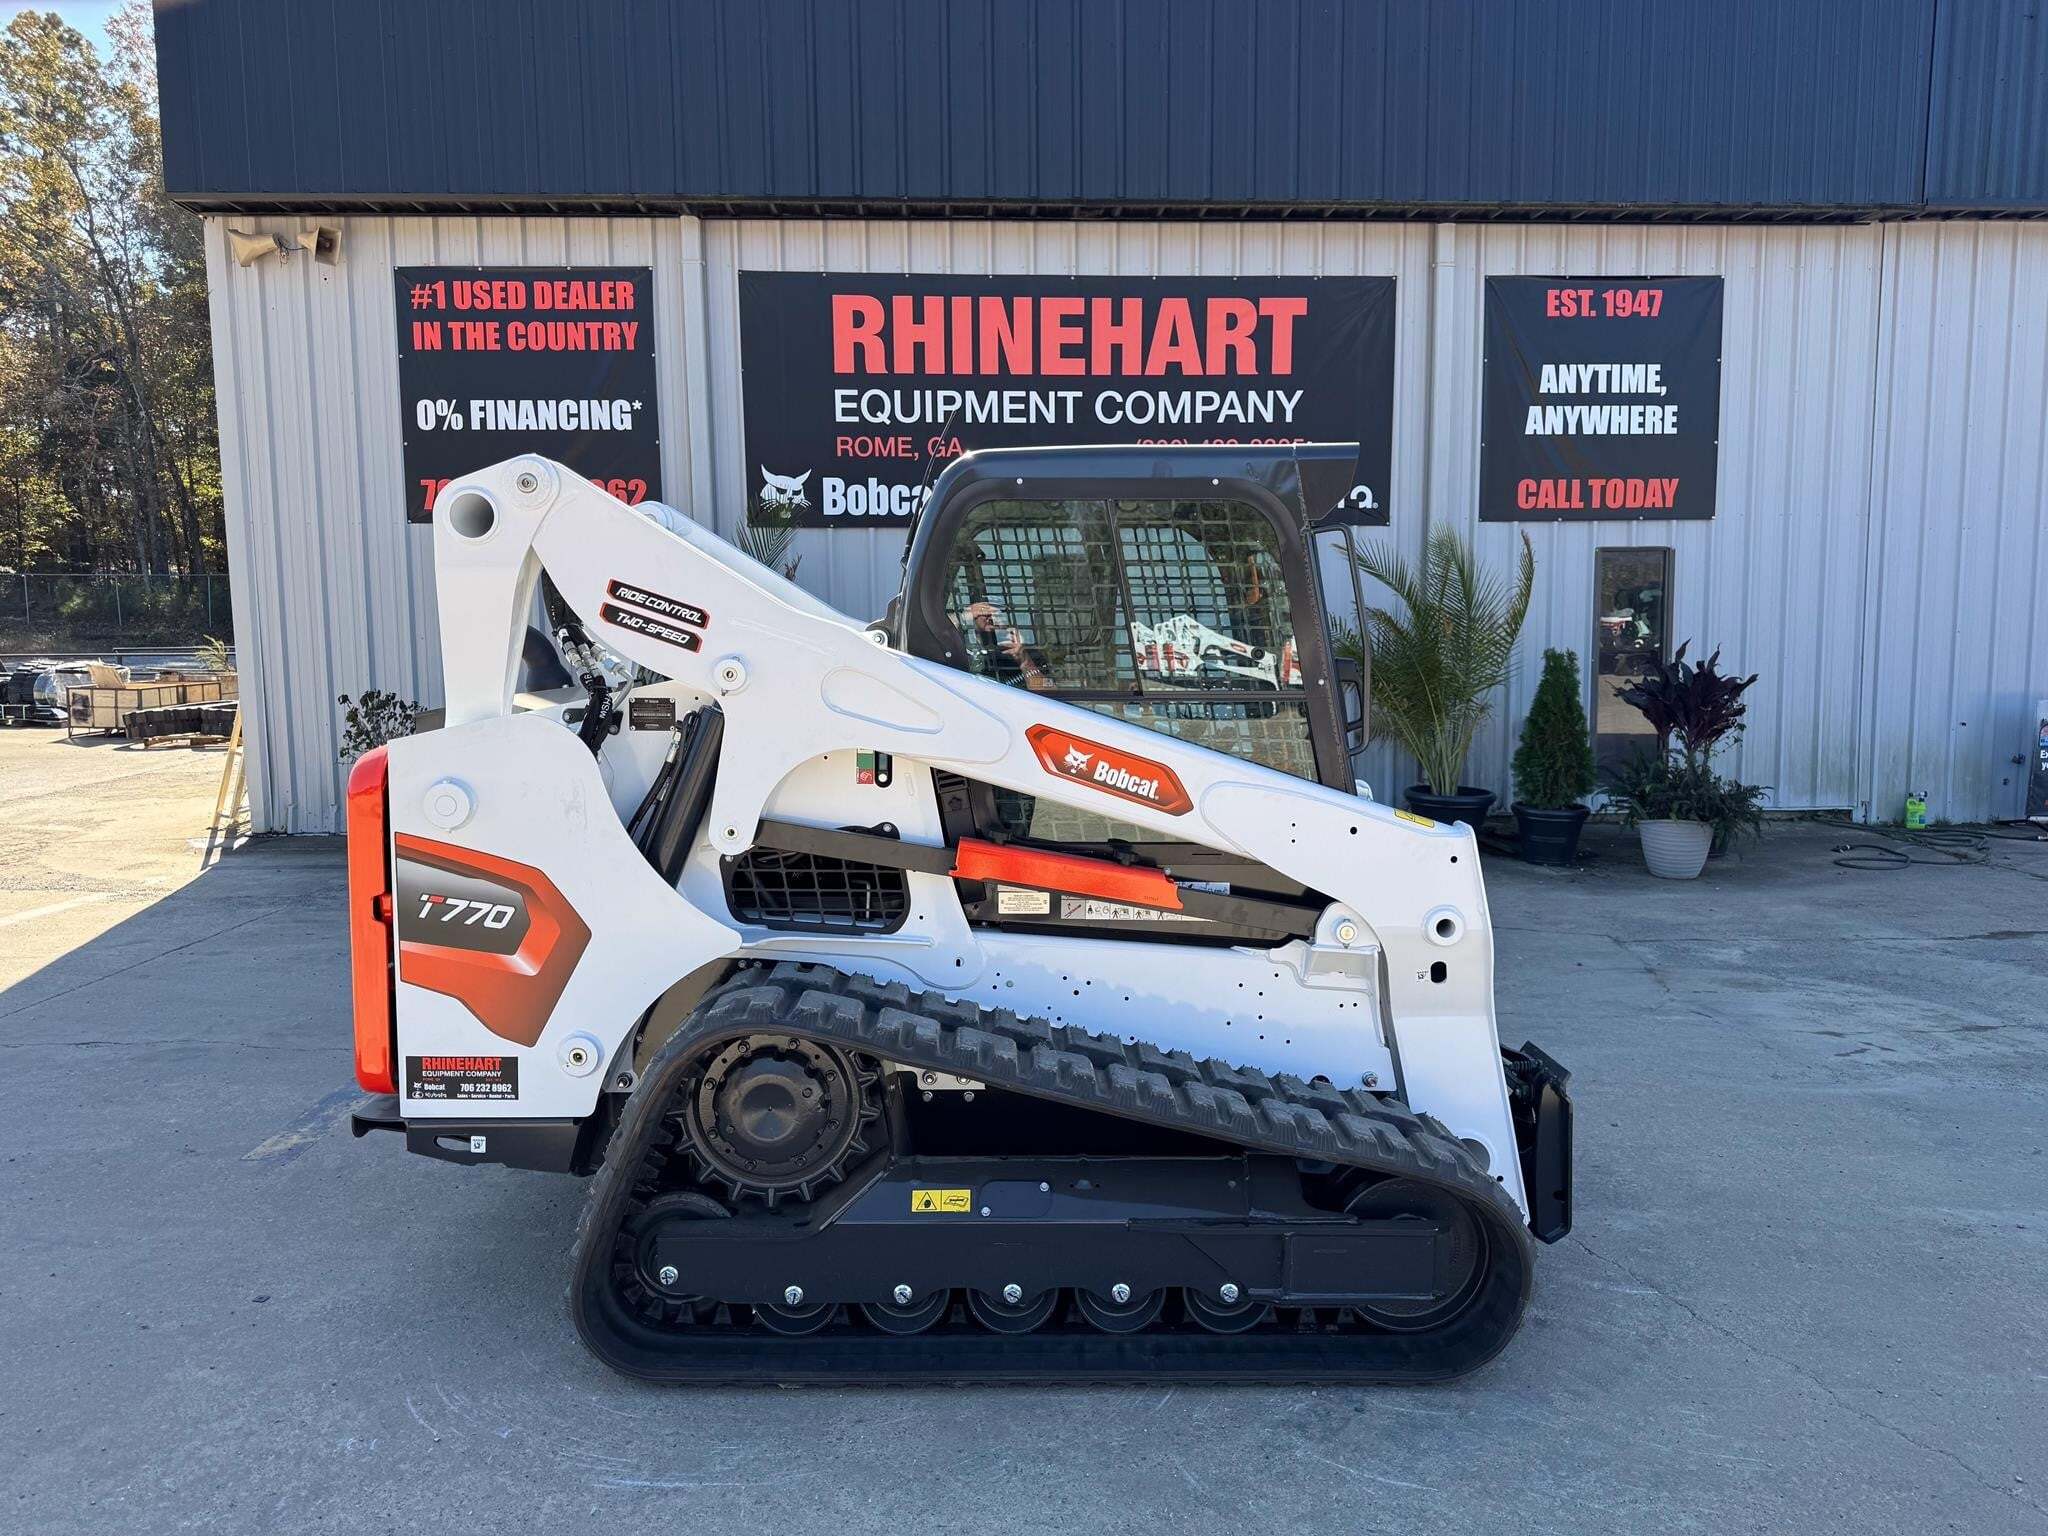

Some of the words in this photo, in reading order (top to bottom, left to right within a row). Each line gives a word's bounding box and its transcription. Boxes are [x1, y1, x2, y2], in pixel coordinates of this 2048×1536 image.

[410, 281, 446, 310] #1
[453, 280, 526, 310] USED
[534, 280, 635, 310] DEALER
[1546, 289, 1596, 317] EST.
[1602, 289, 1663, 317] 1947
[412, 321, 441, 351] IN
[448, 321, 500, 351] THE
[507, 321, 639, 351] COUNTRY
[832, 294, 1307, 375] RHINEHART
[1539, 364, 1667, 396] ANYTIME,
[416, 399, 464, 431] 0%
[834, 388, 1083, 424] EQUIPMENT
[1094, 389, 1304, 425] COMPANY
[1525, 405, 1678, 435] ANYWHERE
[836, 436, 919, 461] ROME,
[927, 436, 964, 457] GA
[822, 477, 937, 516] Bobca
[1517, 479, 1584, 509] CALL
[1589, 478, 1679, 508] TODAY
[616, 587, 648, 604] RIDE
[645, 598, 702, 623] CONTROL
[616, 612, 690, 644] TWO-SPEED
[1093, 760, 1159, 800] Bobcat
[418, 894, 516, 929] T770
[422, 1057, 502, 1070] RHINEHART
[460, 1083, 475, 1092] 706
[475, 1083, 490, 1092] 232
[491, 1083, 512, 1092] 8962
